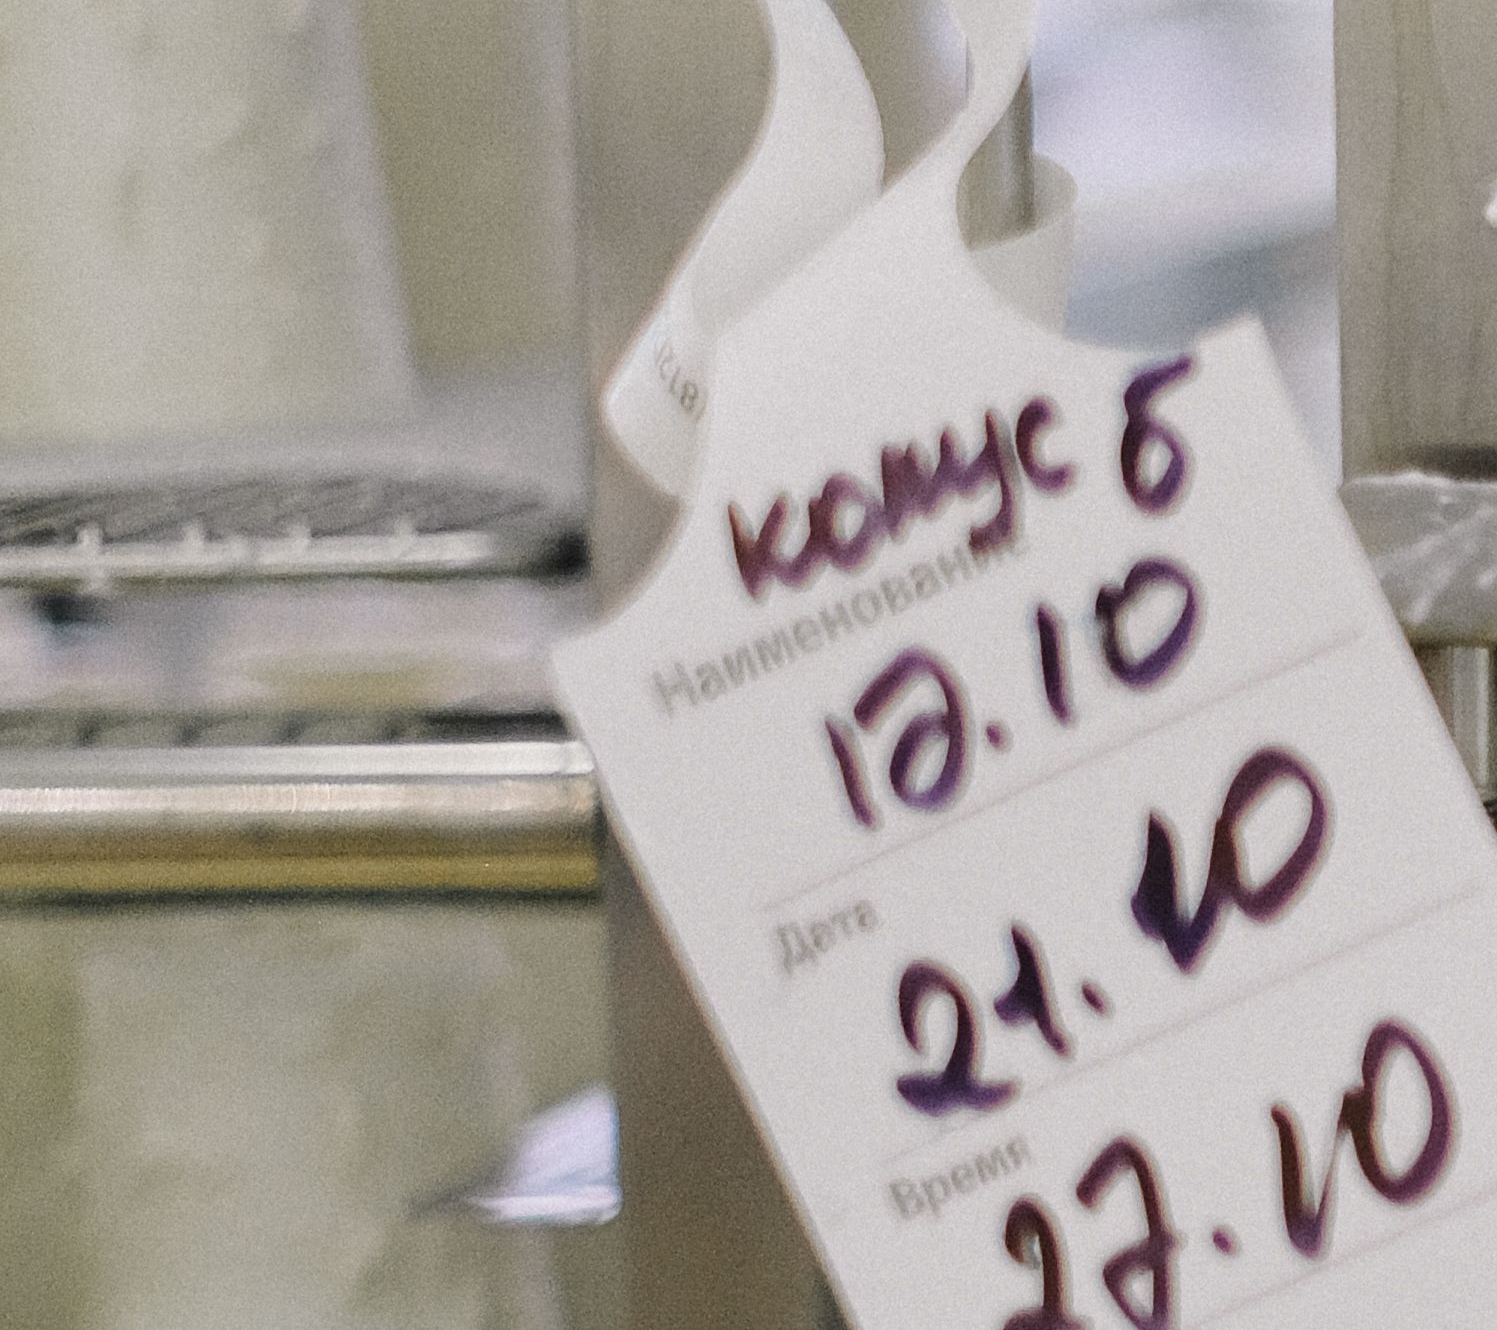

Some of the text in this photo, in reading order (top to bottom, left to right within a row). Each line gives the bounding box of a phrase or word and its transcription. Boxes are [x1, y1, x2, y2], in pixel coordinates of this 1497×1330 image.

[652, 541, 1030, 716] Наименован
[824, 557, 1202, 829] 12.10
[774, 896, 880, 977] Дата
[889, 1132, 1034, 1225] Время
